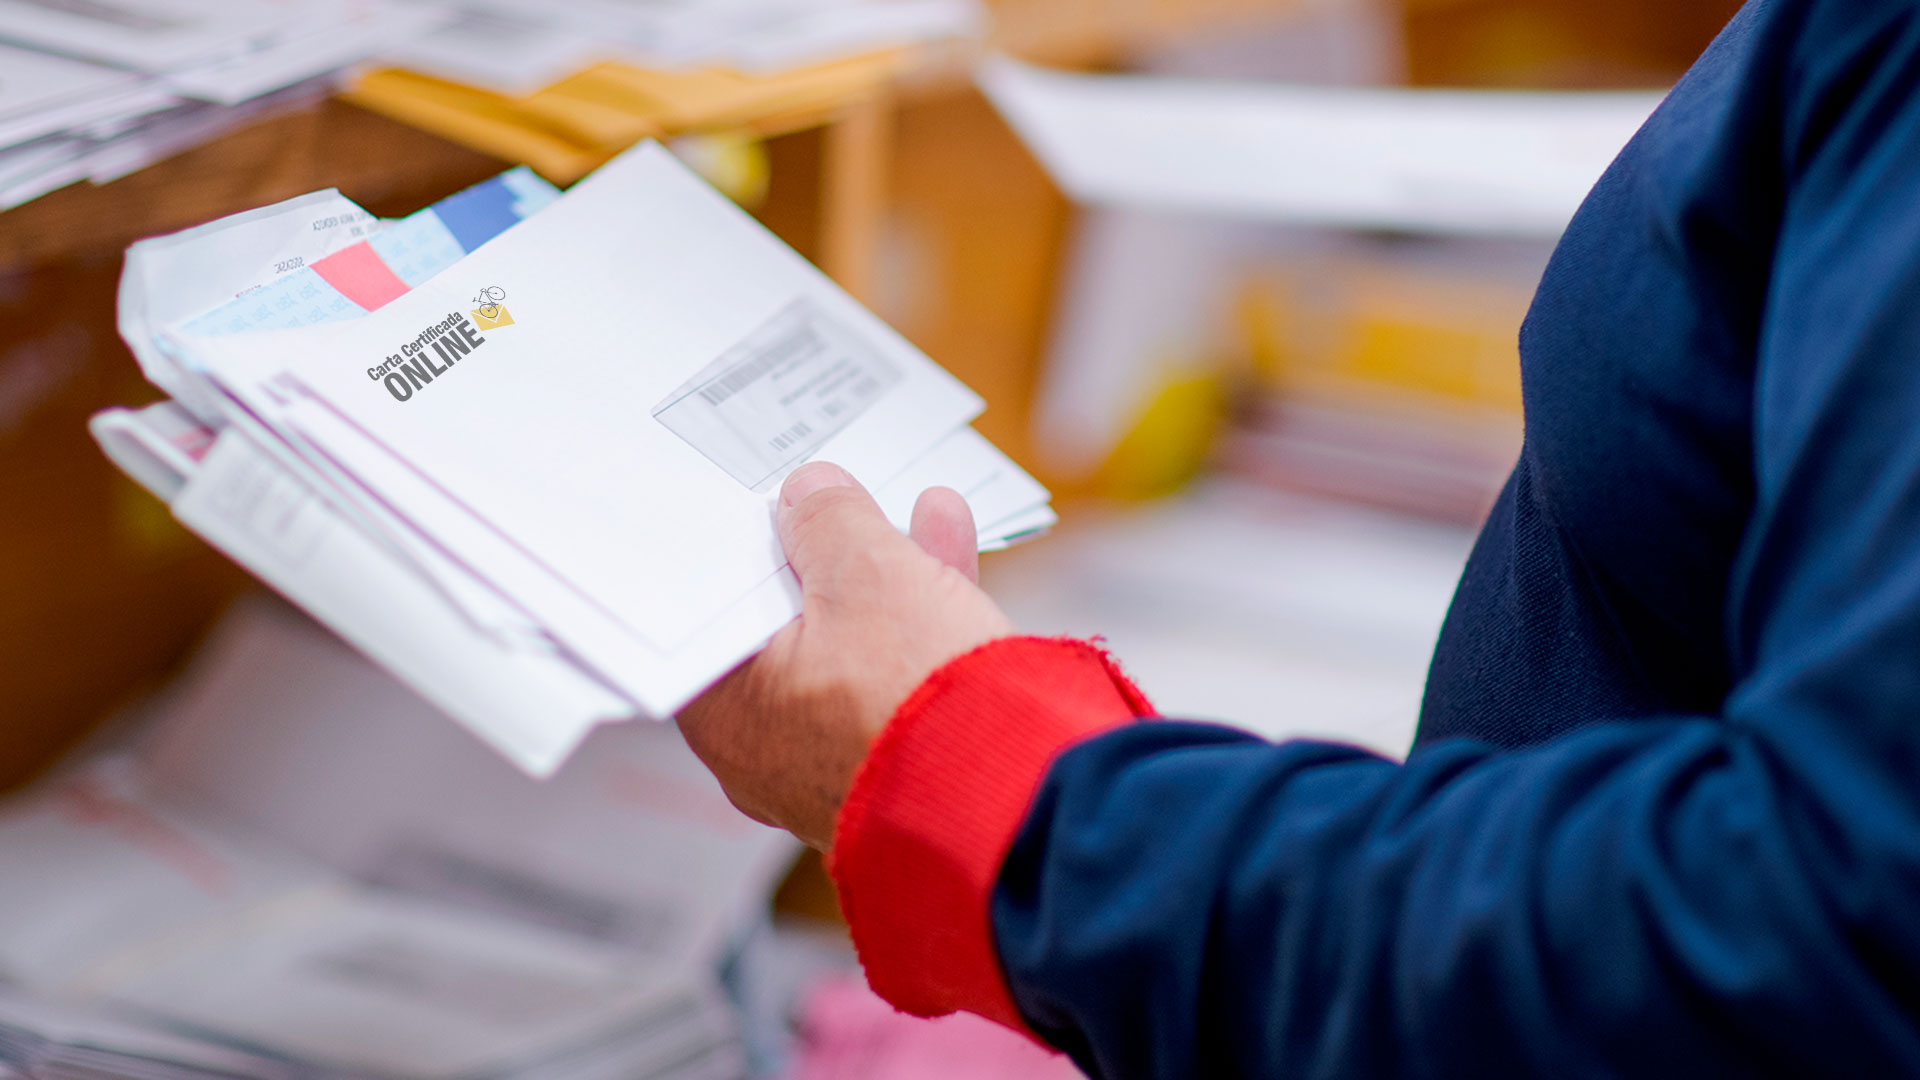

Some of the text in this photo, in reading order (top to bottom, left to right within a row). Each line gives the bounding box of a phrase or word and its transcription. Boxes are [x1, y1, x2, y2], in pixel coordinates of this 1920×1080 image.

[367, 311, 464, 381] Carta Certificada
[383, 319, 486, 402] ONLINE
